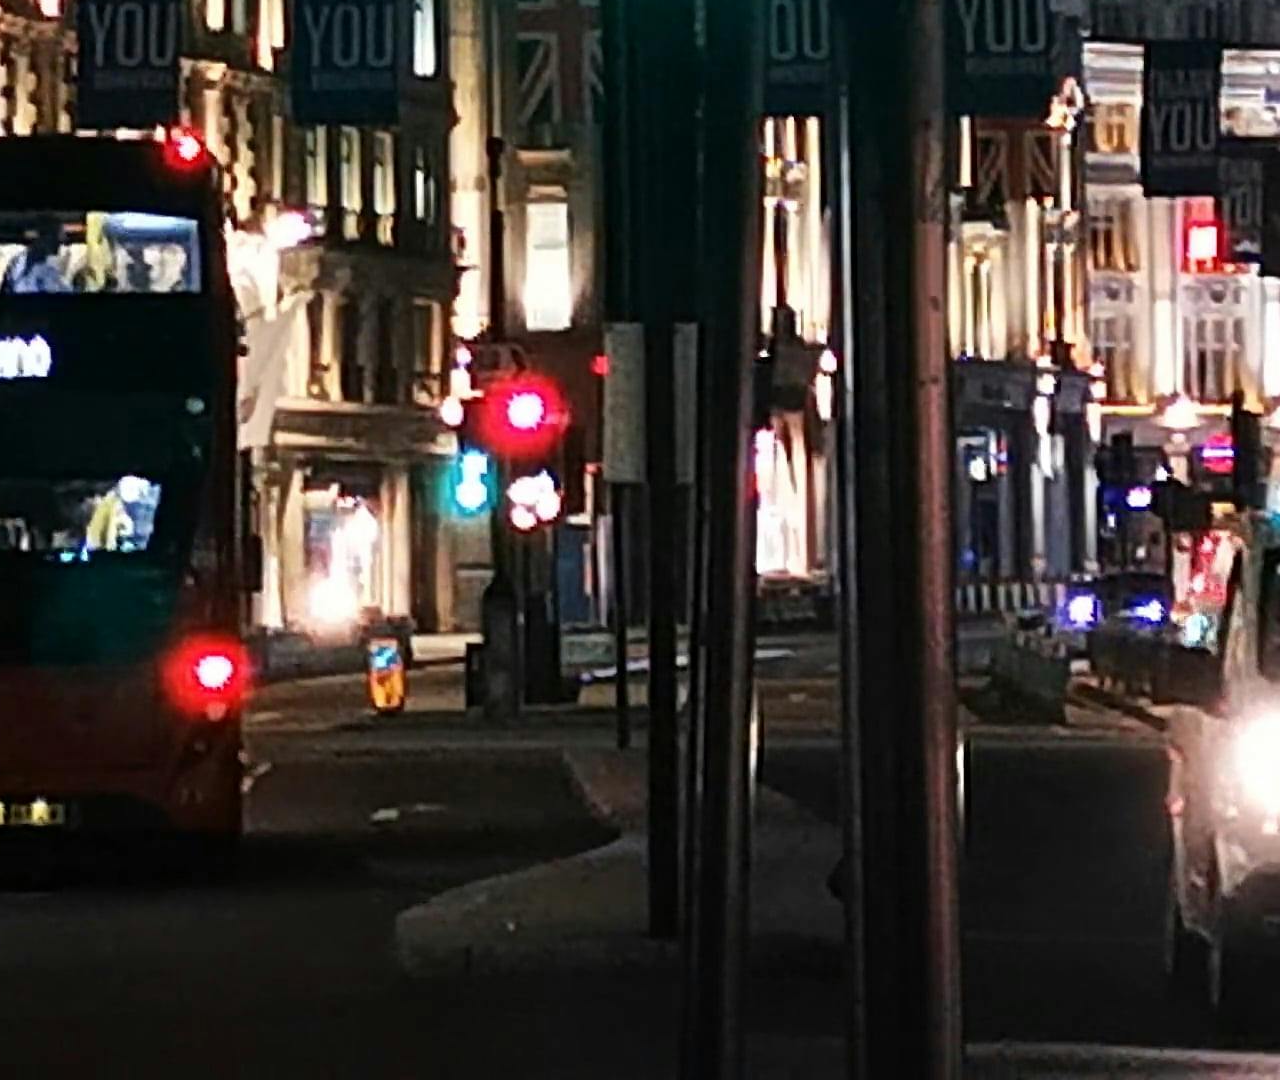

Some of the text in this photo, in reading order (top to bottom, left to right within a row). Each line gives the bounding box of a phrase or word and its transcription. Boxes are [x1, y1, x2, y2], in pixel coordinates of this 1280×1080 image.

[88, 1, 176, 68] YOU
[303, 4, 394, 68] YOU
[1148, 102, 1216, 153] YOU
